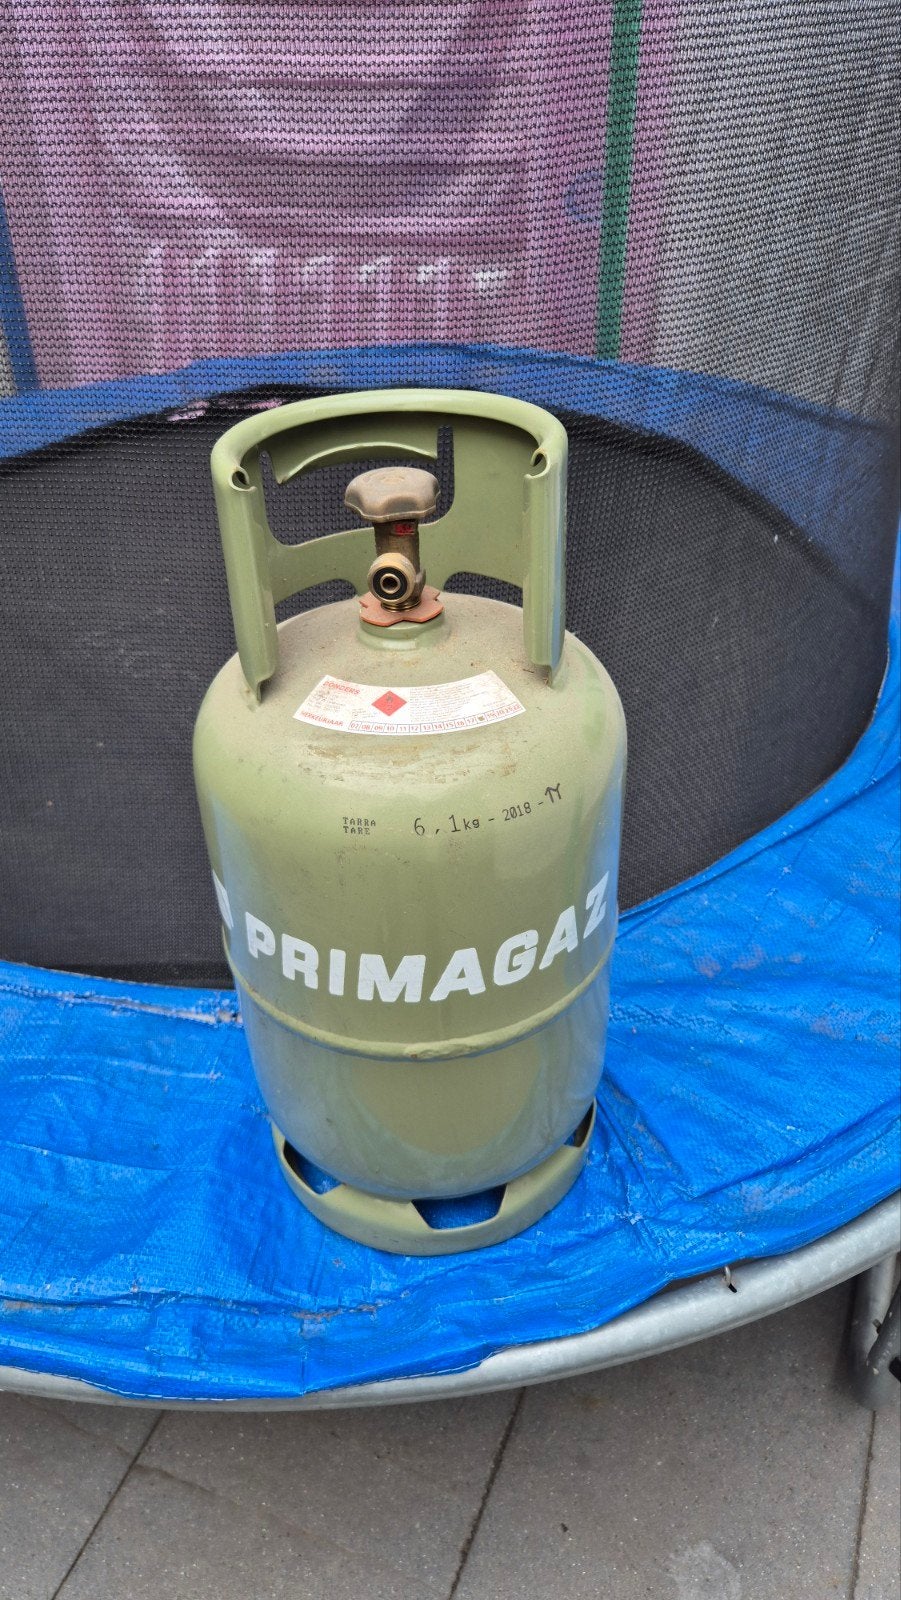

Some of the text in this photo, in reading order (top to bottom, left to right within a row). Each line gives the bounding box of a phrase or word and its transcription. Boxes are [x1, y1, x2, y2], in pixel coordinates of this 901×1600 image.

[501, 801, 532, 822] 2018
[342, 816, 376, 827] TARRA
[342, 826, 371, 835] TARE
[245, 871, 609, 1003] PRIMAGAZ
